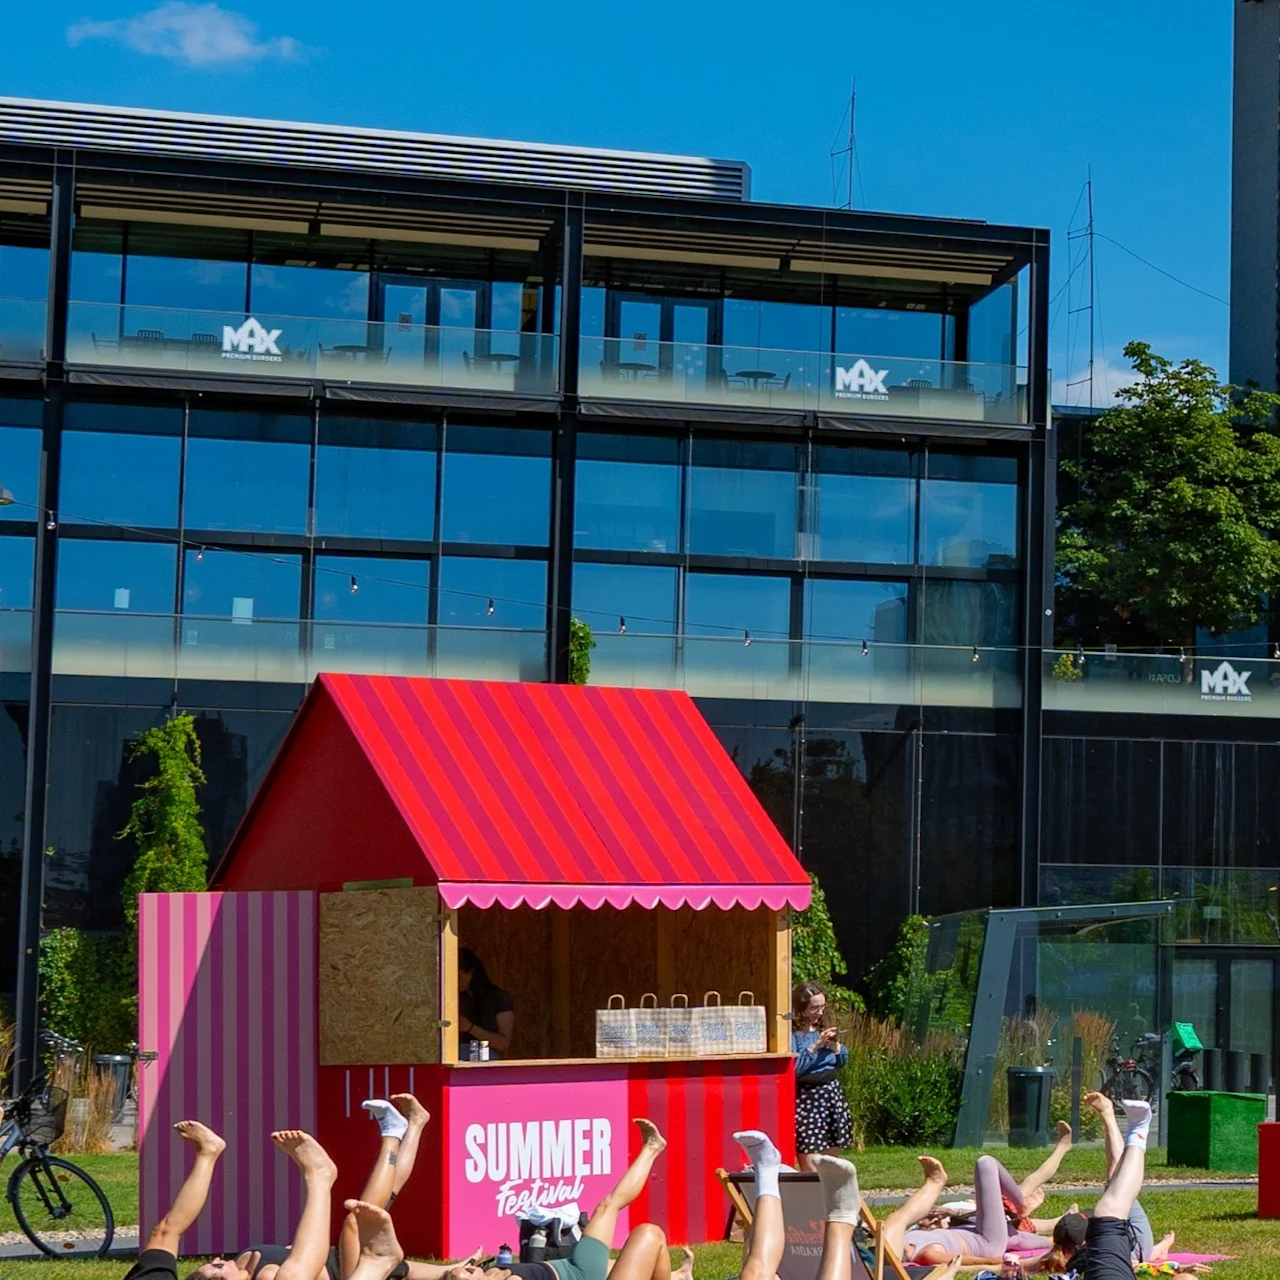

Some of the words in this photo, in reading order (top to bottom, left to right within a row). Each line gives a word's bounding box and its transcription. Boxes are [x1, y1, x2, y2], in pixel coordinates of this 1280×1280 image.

[223, 317, 283, 355] MAX
[835, 358, 889, 394] MAX
[1201, 661, 1253, 695] MAX
[464, 1117, 612, 1183] SUMMER
[495, 1174, 584, 1217] Festival
